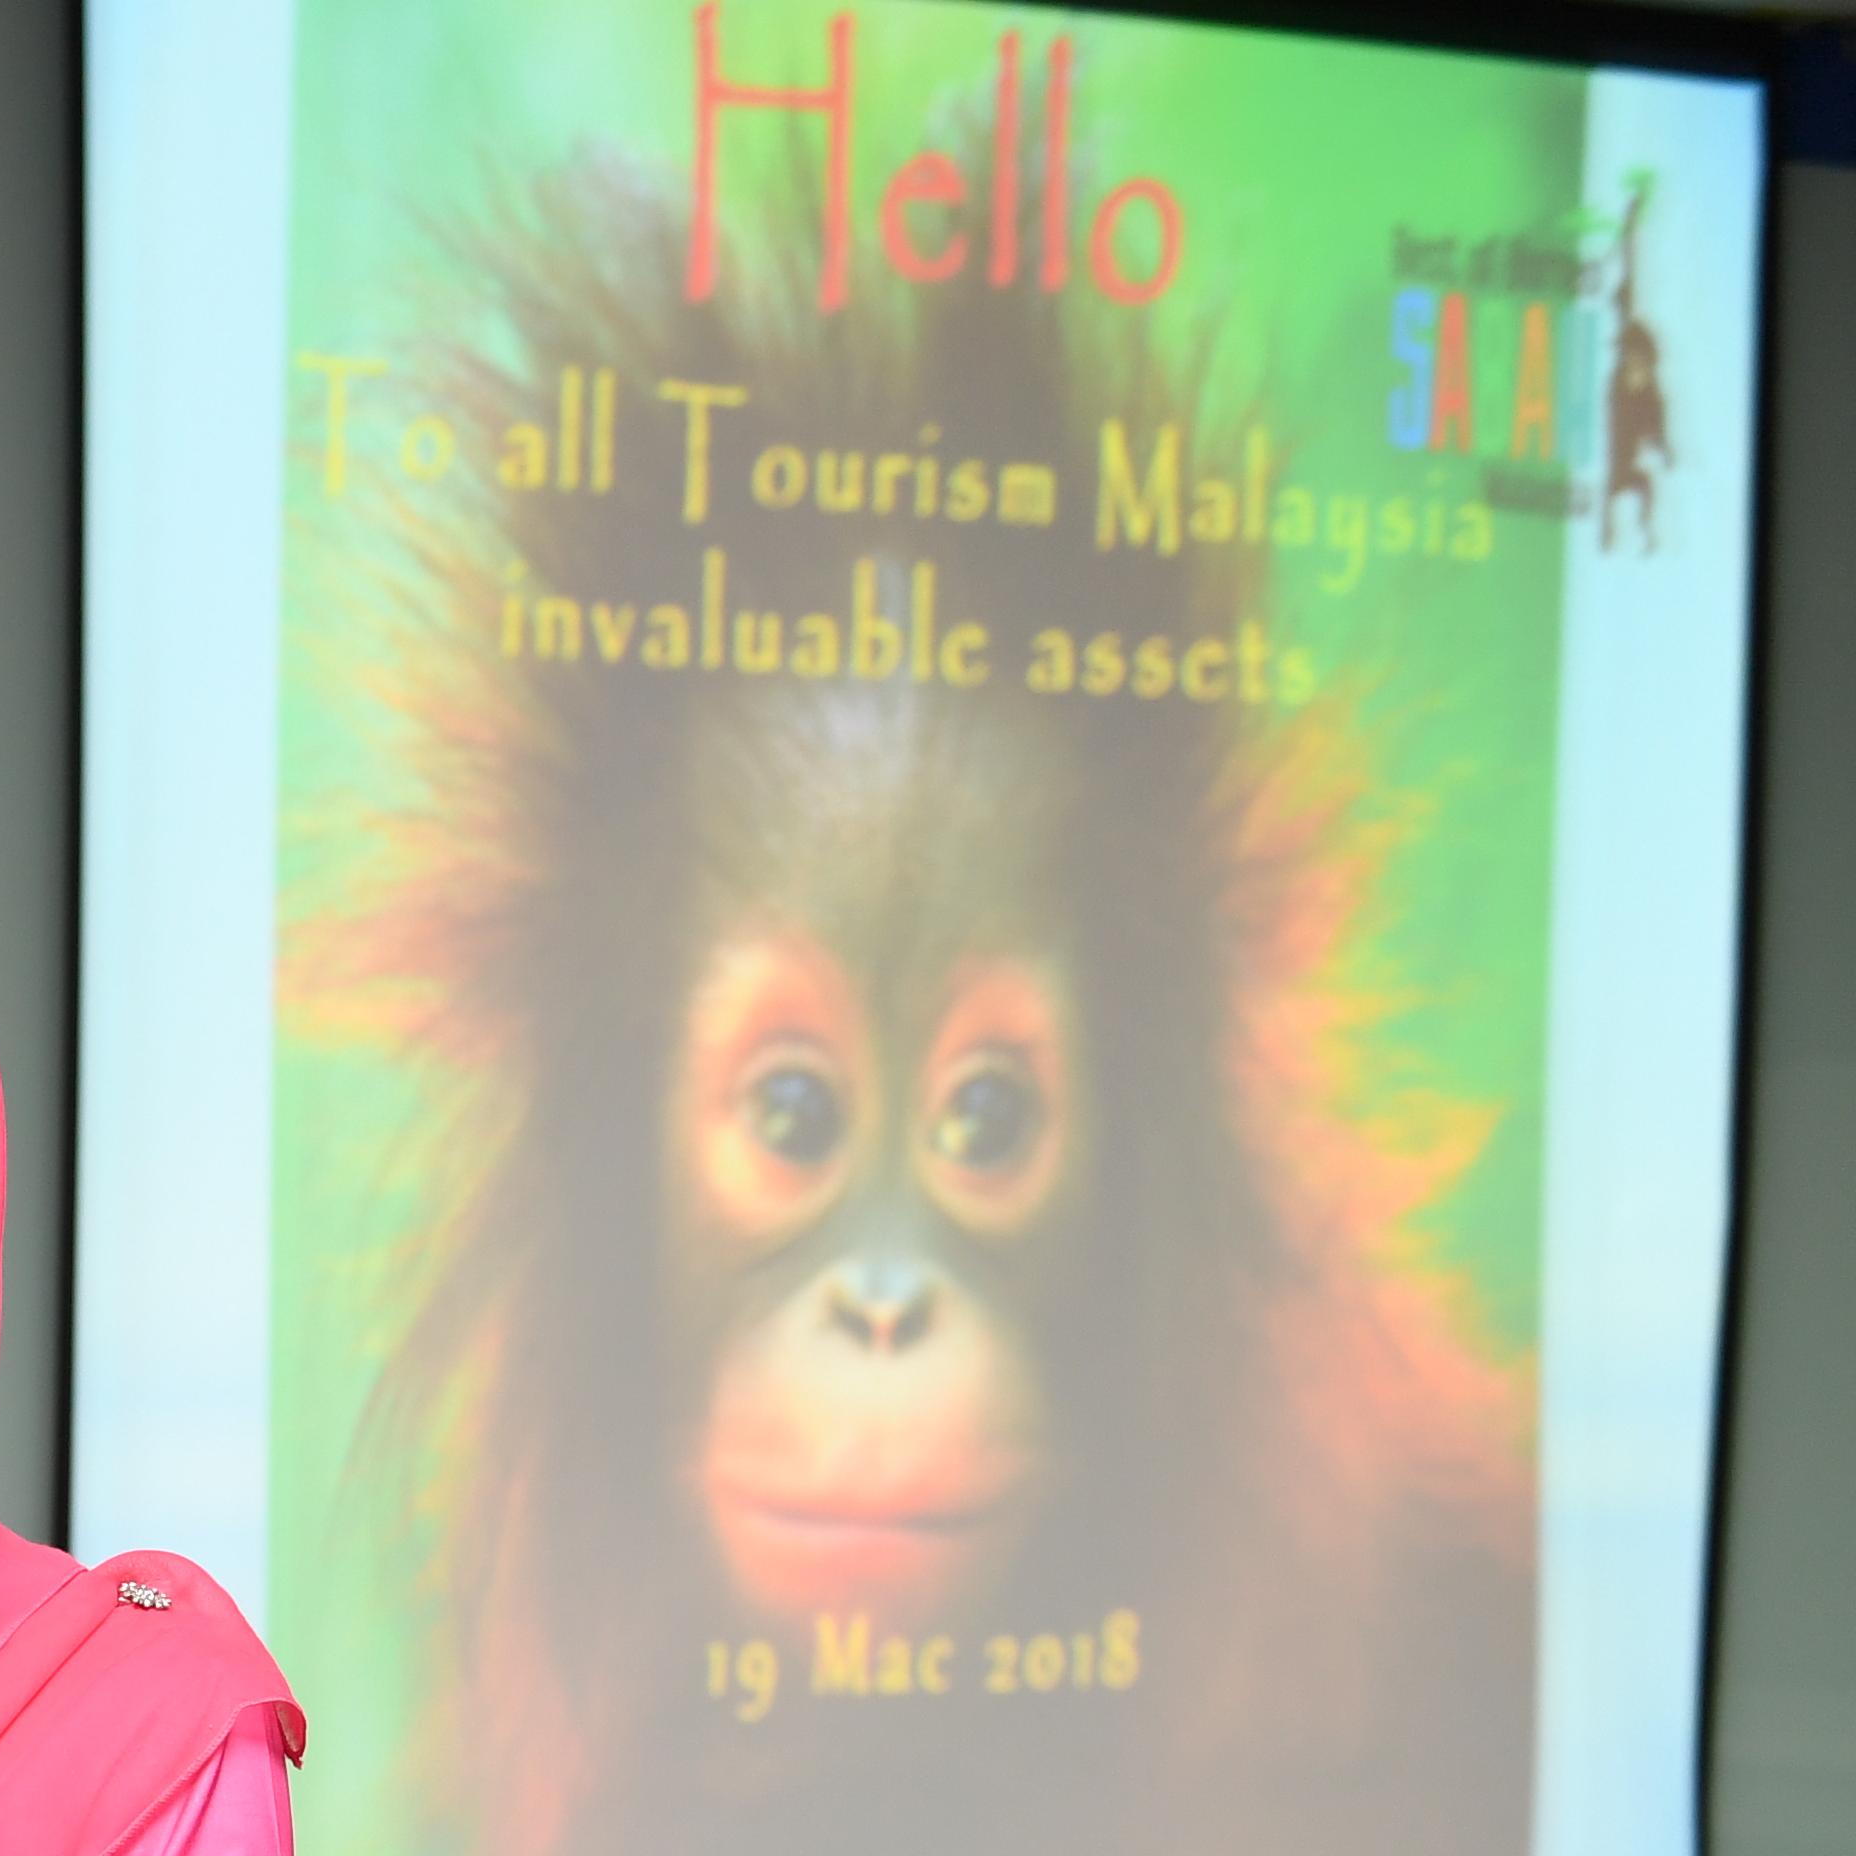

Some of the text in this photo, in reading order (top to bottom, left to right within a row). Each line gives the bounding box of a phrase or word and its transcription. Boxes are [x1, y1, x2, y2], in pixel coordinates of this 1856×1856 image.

[684, 2, 1184, 314] Hello
[298, 352, 1494, 597] To all Tourism Malaysia
[500, 549, 1316, 710] invaluable assets
[706, 1607, 1142, 1724] 19 Mac 2018
